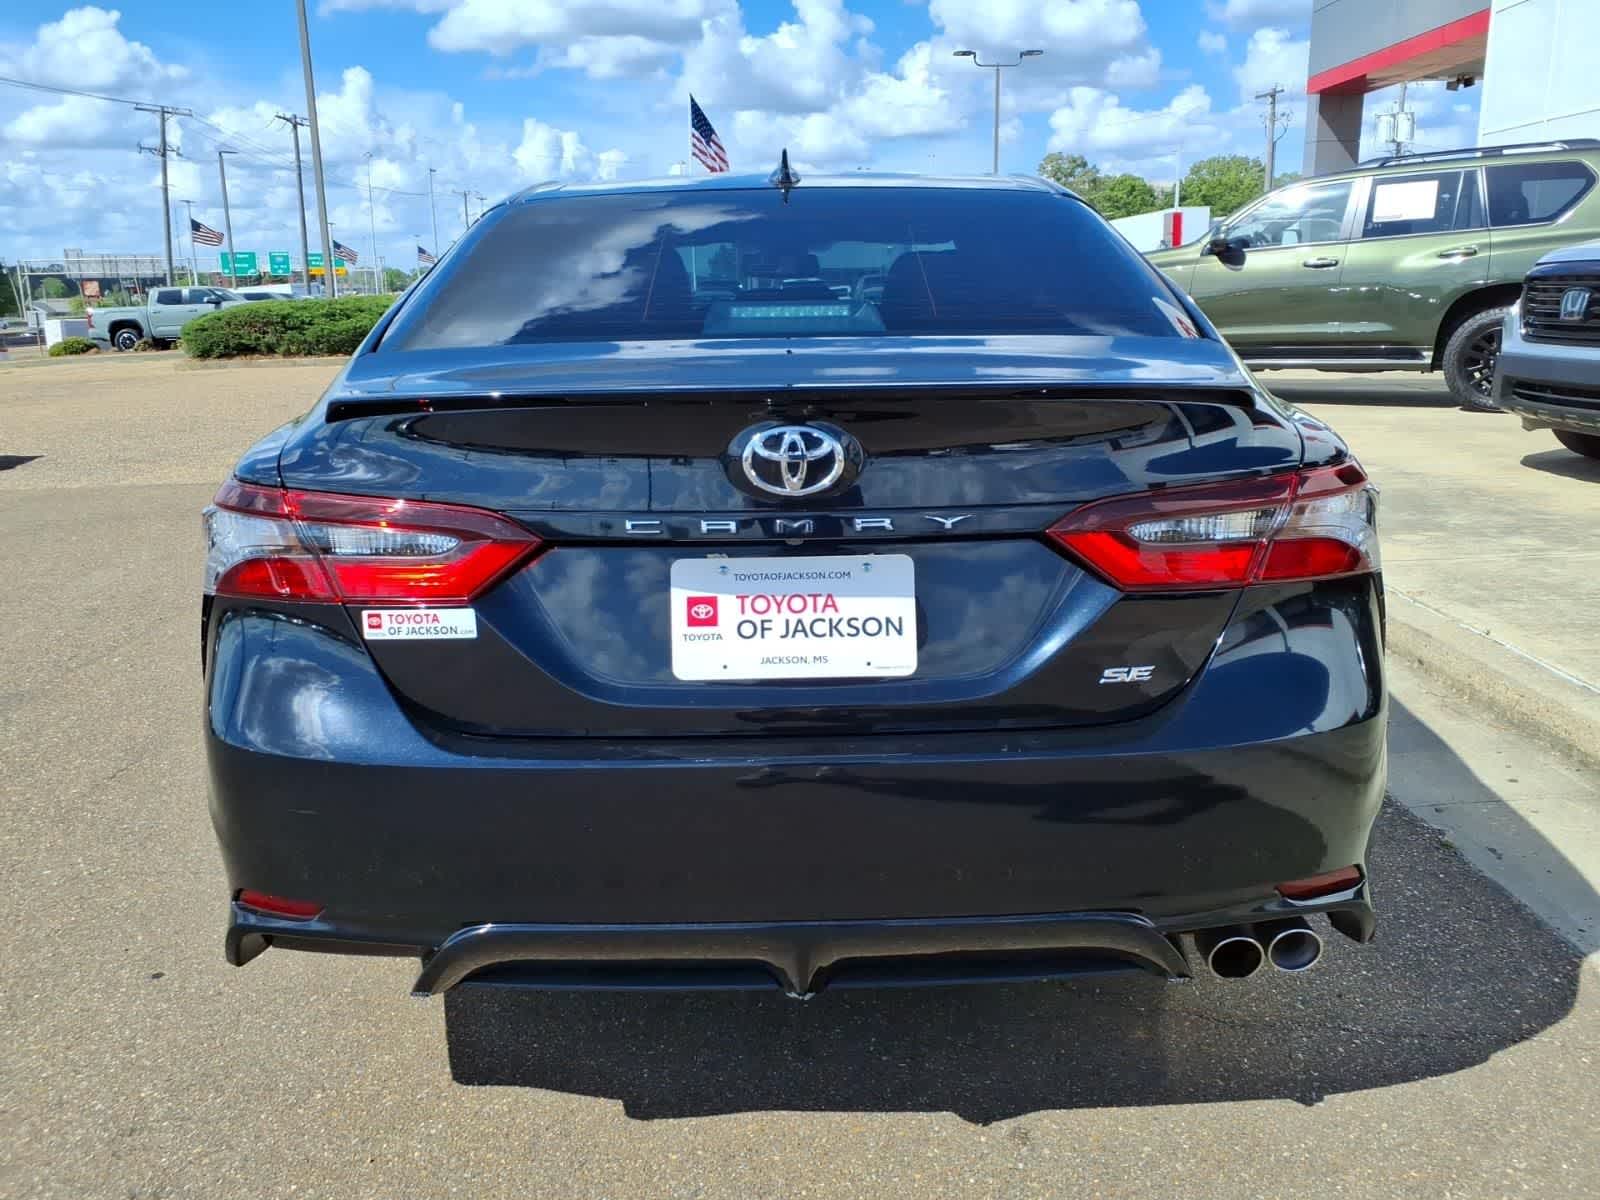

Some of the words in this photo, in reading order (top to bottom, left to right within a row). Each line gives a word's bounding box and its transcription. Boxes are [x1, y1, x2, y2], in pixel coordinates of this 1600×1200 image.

[625, 514, 976, 534] CAMRY
[734, 571, 851, 582] TOYOTAOFJACKSON.COM
[736, 593, 839, 615] TOYOTA
[388, 614, 440, 625] TOYOTA
[388, 626, 403, 636] OF
[737, 619, 773, 640] OF
[780, 616, 904, 639] JACKSON
[682, 633, 723, 642] TOYOTA
[760, 656, 810, 665] JACKSON,
[813, 655, 829, 664] MS
[1099, 665, 1156, 684] SE
